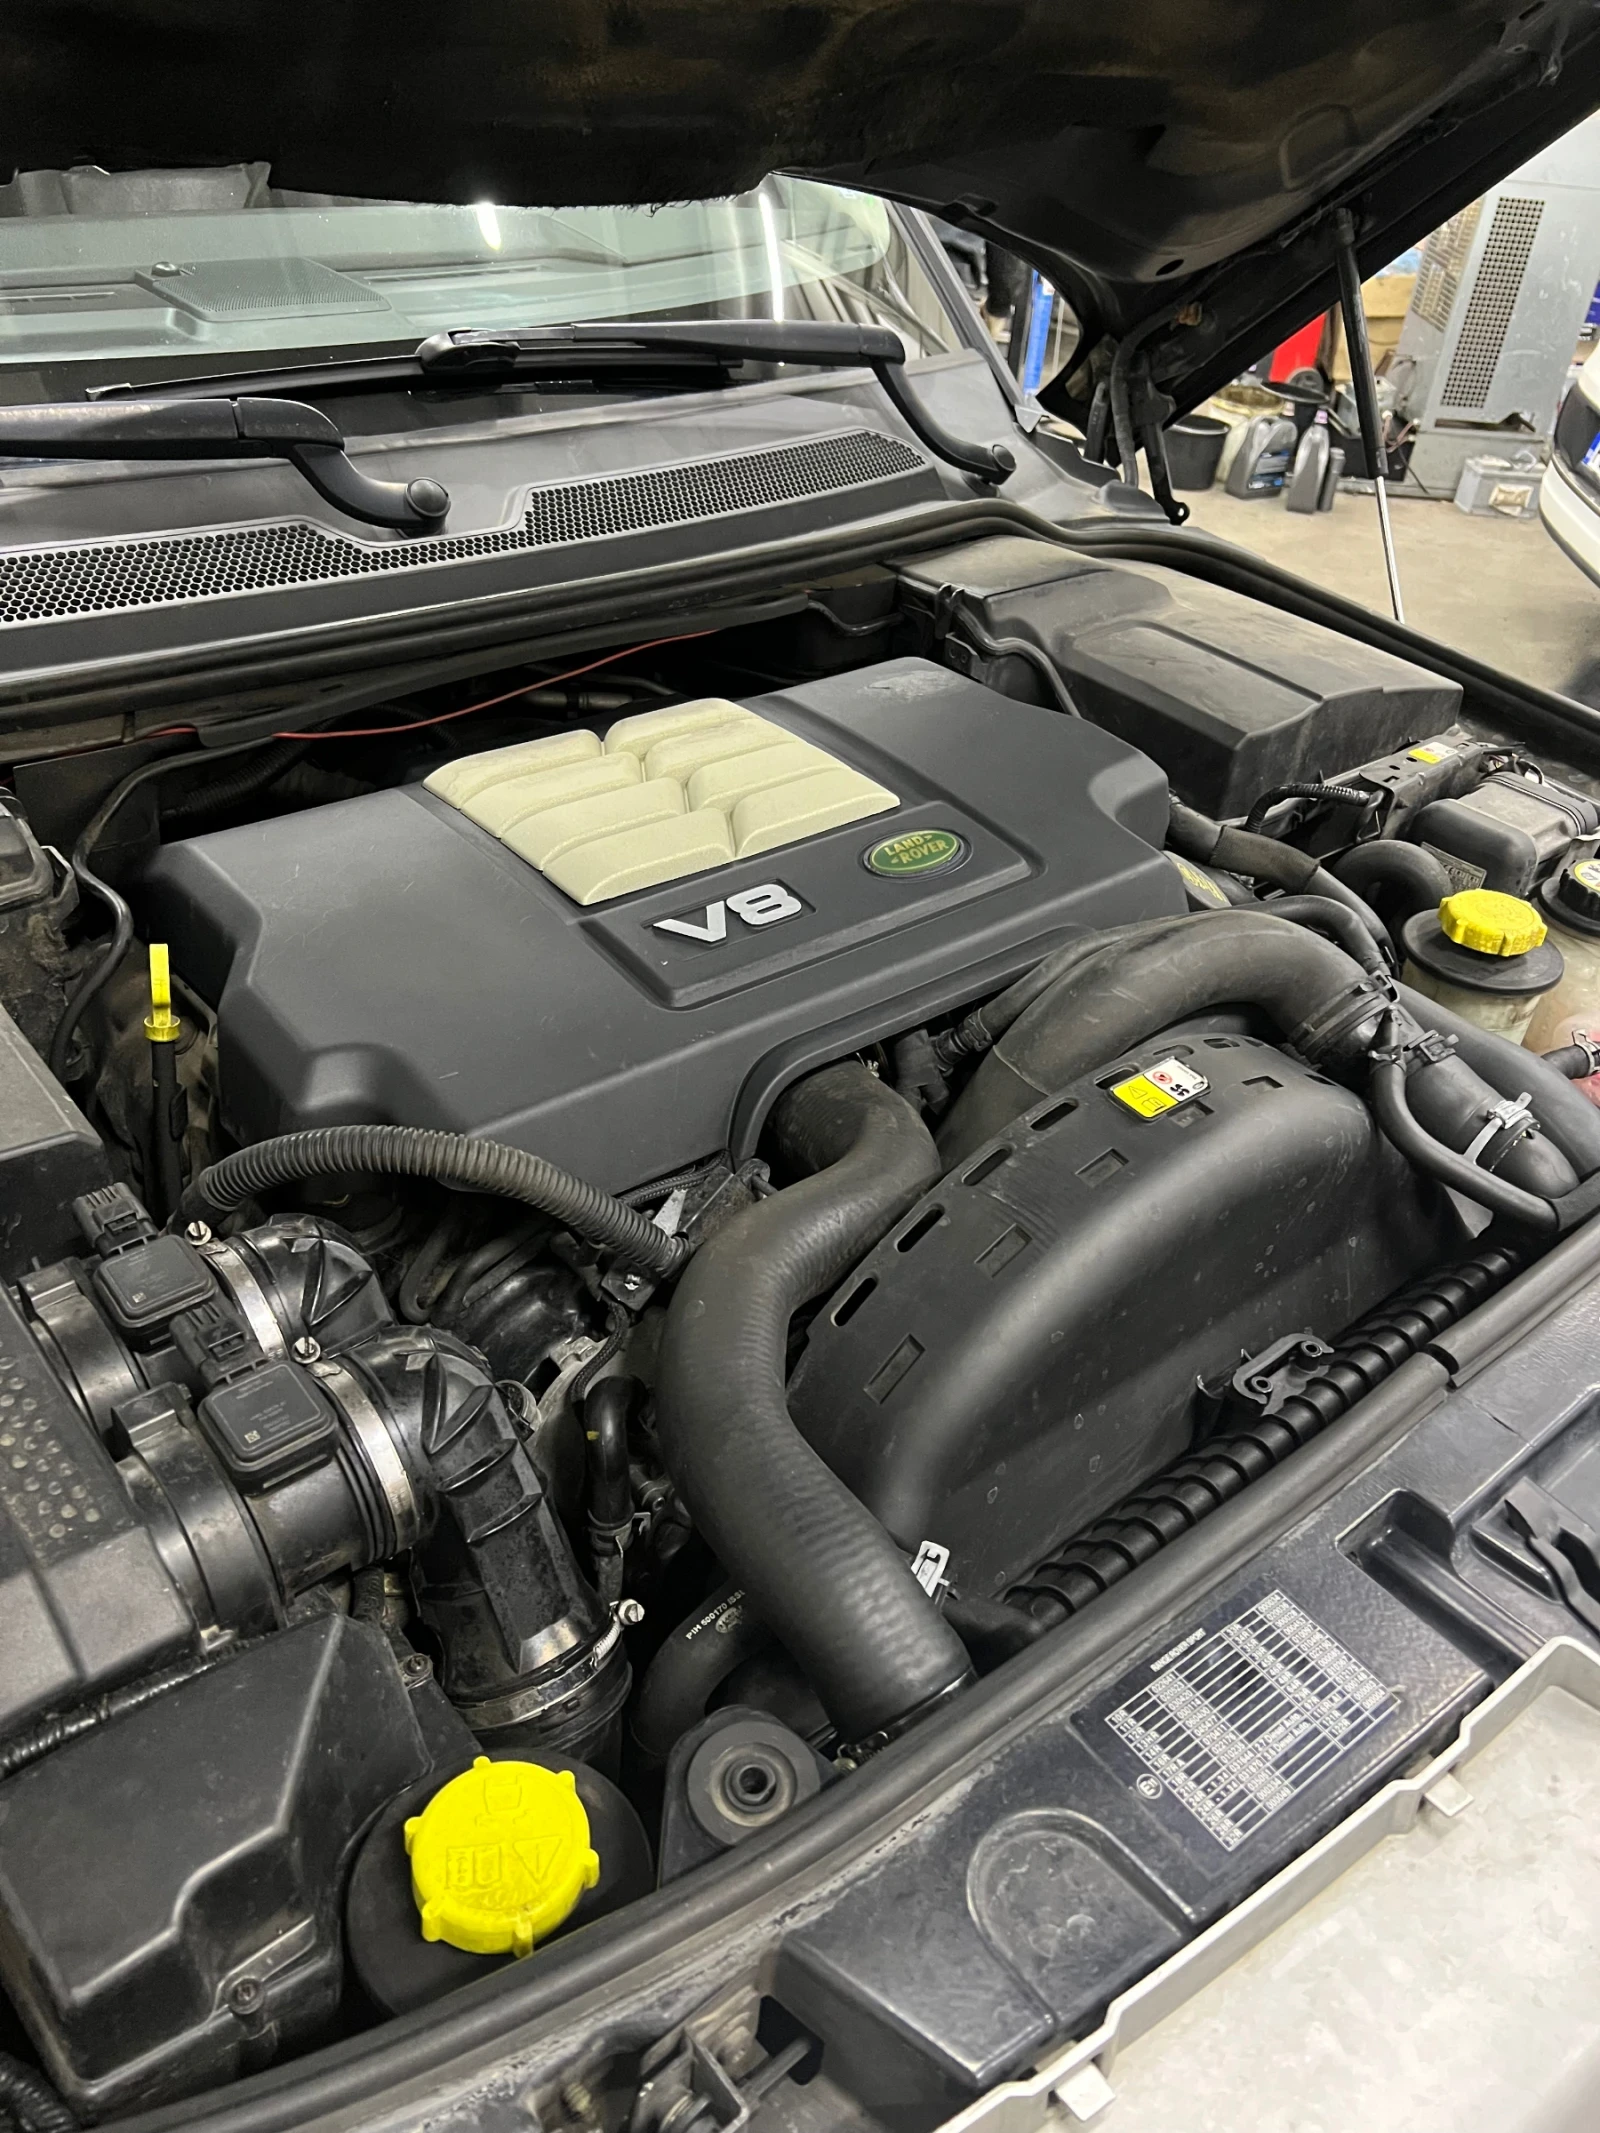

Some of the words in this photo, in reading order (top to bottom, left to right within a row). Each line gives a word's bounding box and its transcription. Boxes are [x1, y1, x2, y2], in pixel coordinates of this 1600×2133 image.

[883, 834, 923, 855] LAND
[901, 839, 950, 865] ROVER
[652, 882, 803, 943] V8
[685, 1624, 702, 1640] PIH
[1149, 1653, 1173, 1672] RANGE
[1167, 1640, 1190, 1658] ROVER
[1184, 1627, 1207, 1645] SPORT
[1110, 1709, 1129, 1724] 10R
[1175, 1697, 1202, 1719] 000114
[1118, 1717, 1137, 1733] 11R
[1127, 1726, 1146, 1742] 12R
[1201, 1723, 1228, 1746] 070411
[1144, 1744, 1163, 1760] 14R
[1179, 1780, 1198, 1797] 21R
[1188, 1789, 1207, 1806] 24R
[1197, 1799, 1216, 1816] 24R
